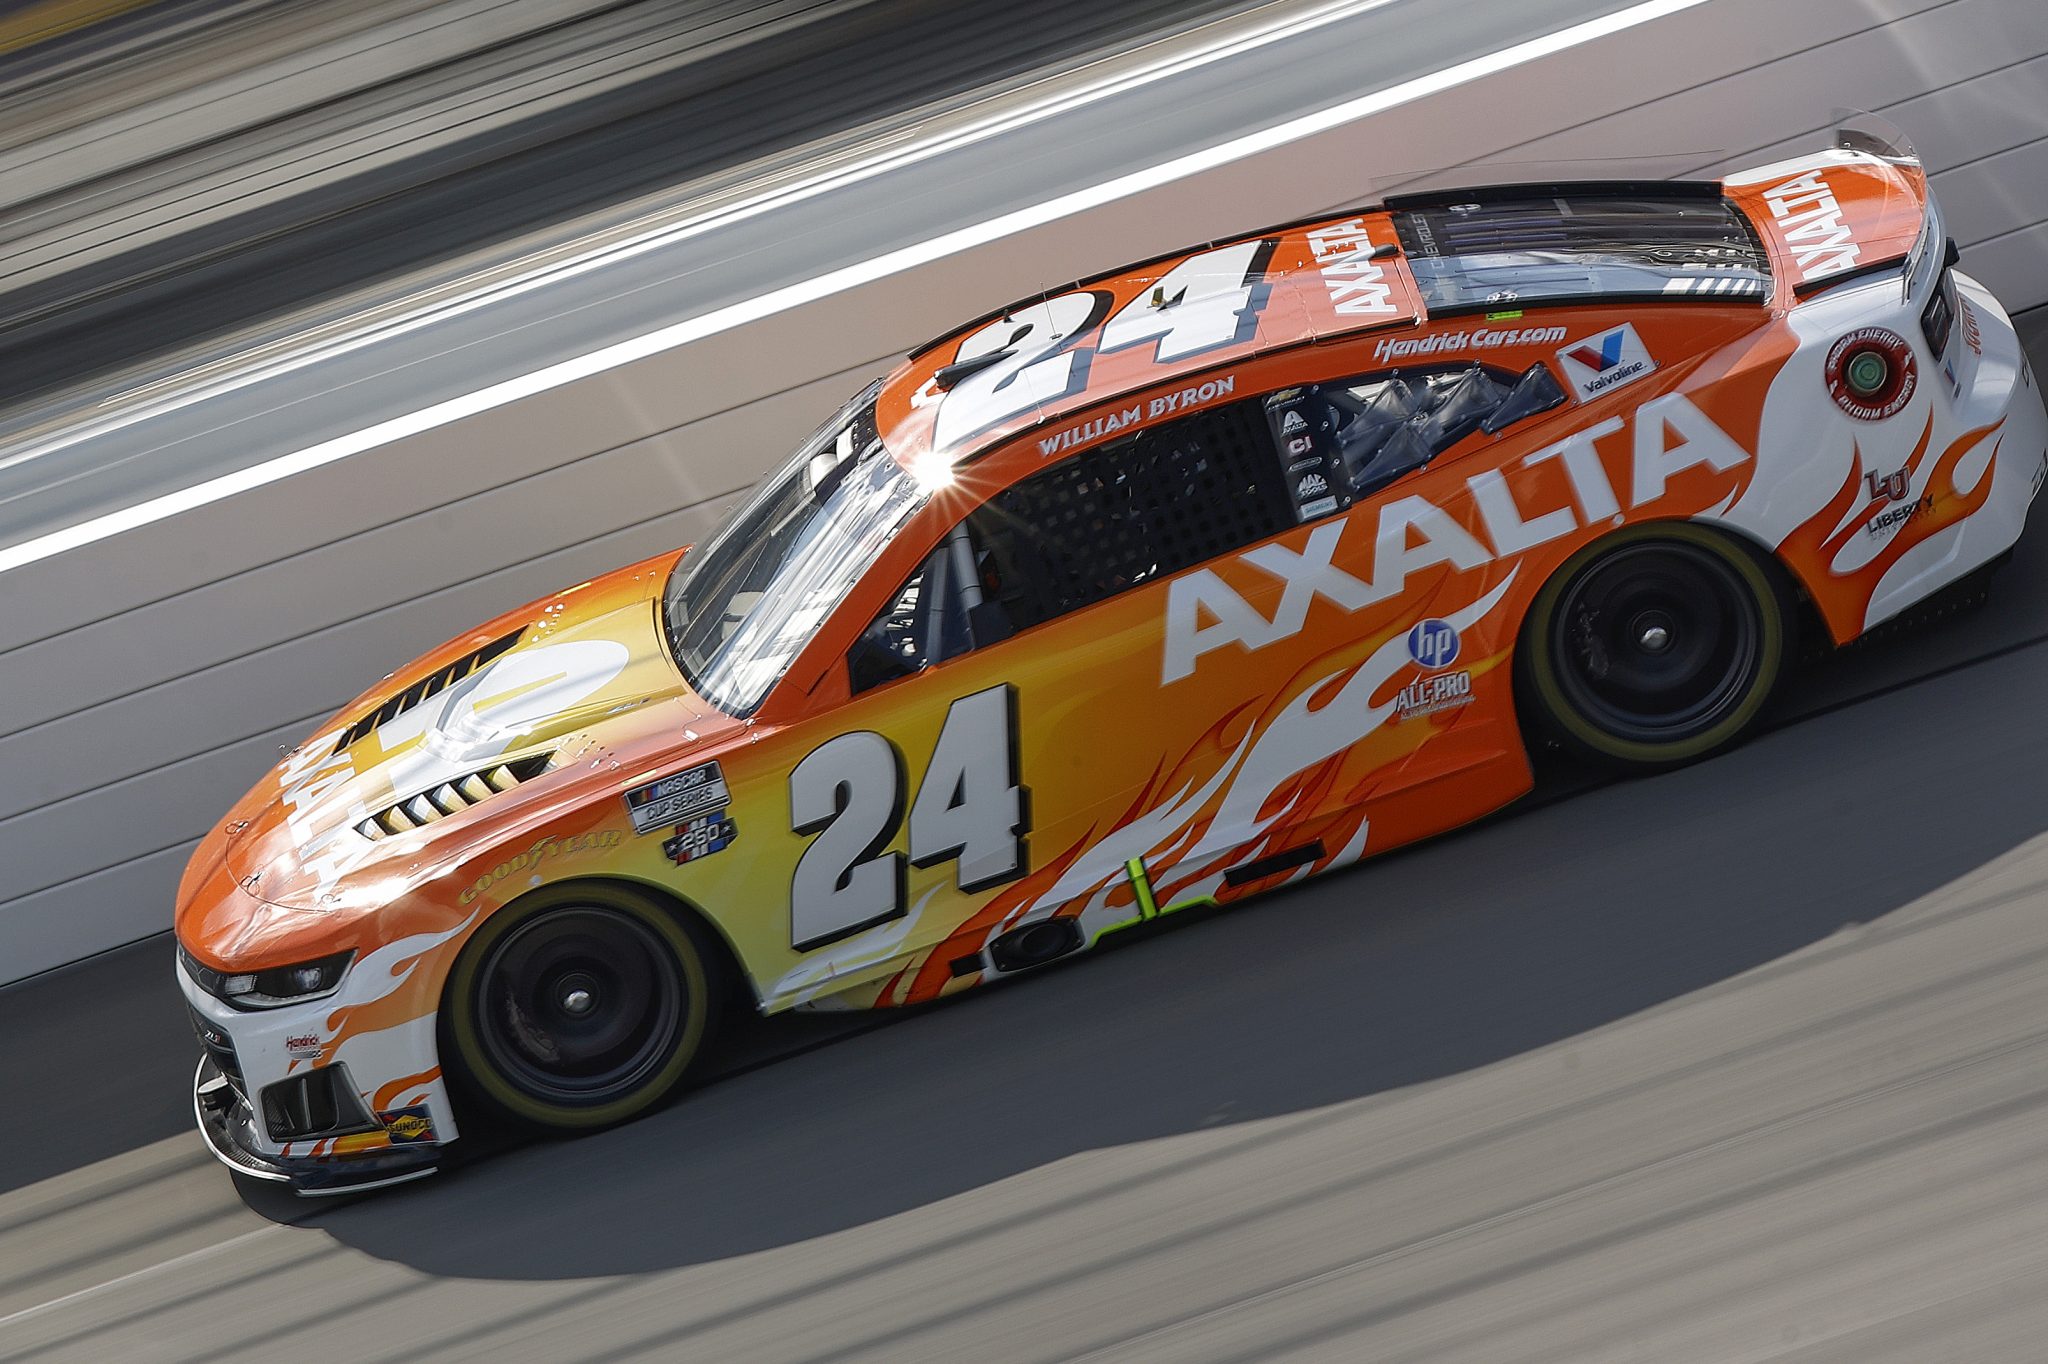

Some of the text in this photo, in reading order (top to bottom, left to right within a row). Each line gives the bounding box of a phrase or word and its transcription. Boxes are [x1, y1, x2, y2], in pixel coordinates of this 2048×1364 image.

[1762, 170, 1860, 281] AXALTA
[1306, 218, 1397, 314] AXALTA
[932, 236, 1281, 452] 24
[1582, 359, 1643, 393] Valvoline
[1038, 374, 1235, 457] WILLIAM BYRON
[1863, 465, 1911, 502] LU
[1160, 392, 1751, 688] AXALTA
[1415, 620, 1453, 667] hp
[1397, 671, 1471, 712] ALL-PRO
[646, 785, 713, 821] CUP SERIES
[657, 768, 706, 797] NASCAR
[680, 823, 719, 852] 250
[788, 682, 1031, 953] 24
[458, 829, 623, 904] GOODYEAR
[388, 1117, 433, 1132] SUNOCO
